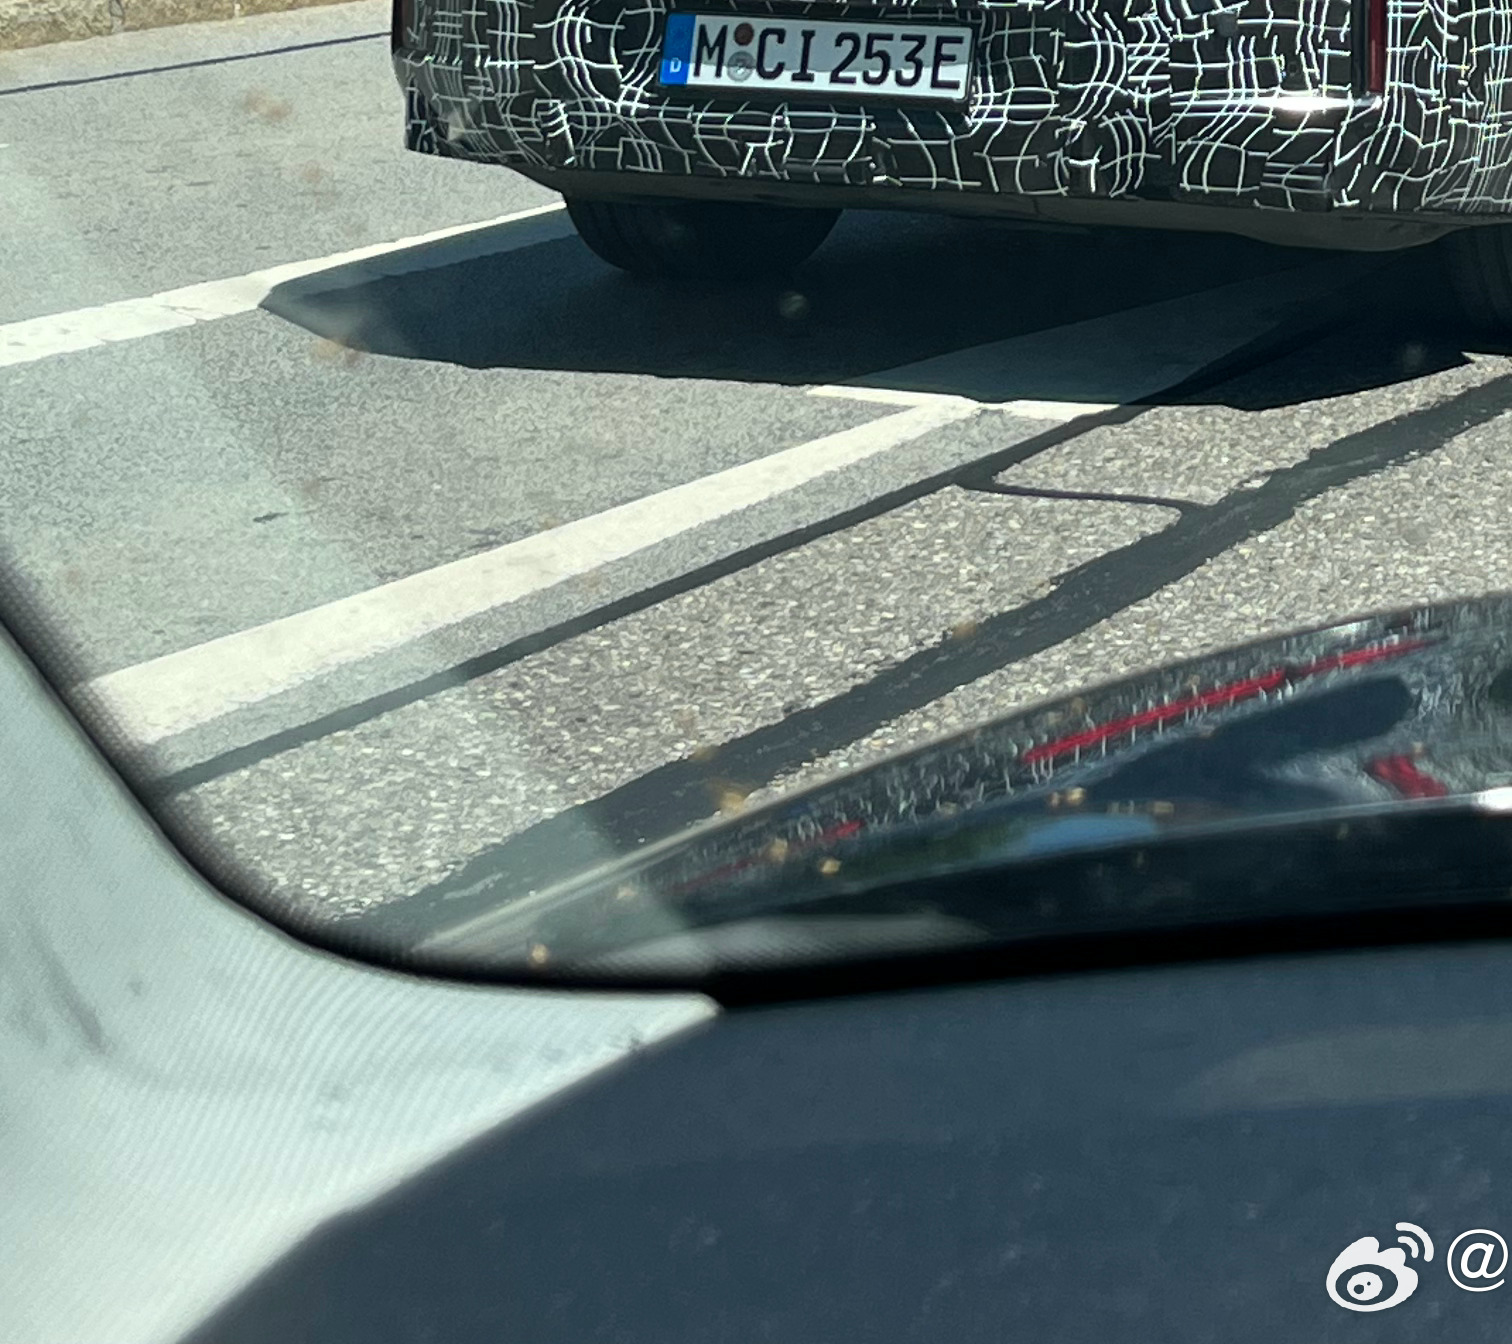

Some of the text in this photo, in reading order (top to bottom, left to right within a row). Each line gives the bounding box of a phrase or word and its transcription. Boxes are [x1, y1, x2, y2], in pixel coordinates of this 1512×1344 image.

[669, 57, 682, 73] D
[694, 24, 728, 78] M
[829, 32, 965, 90] 253E
